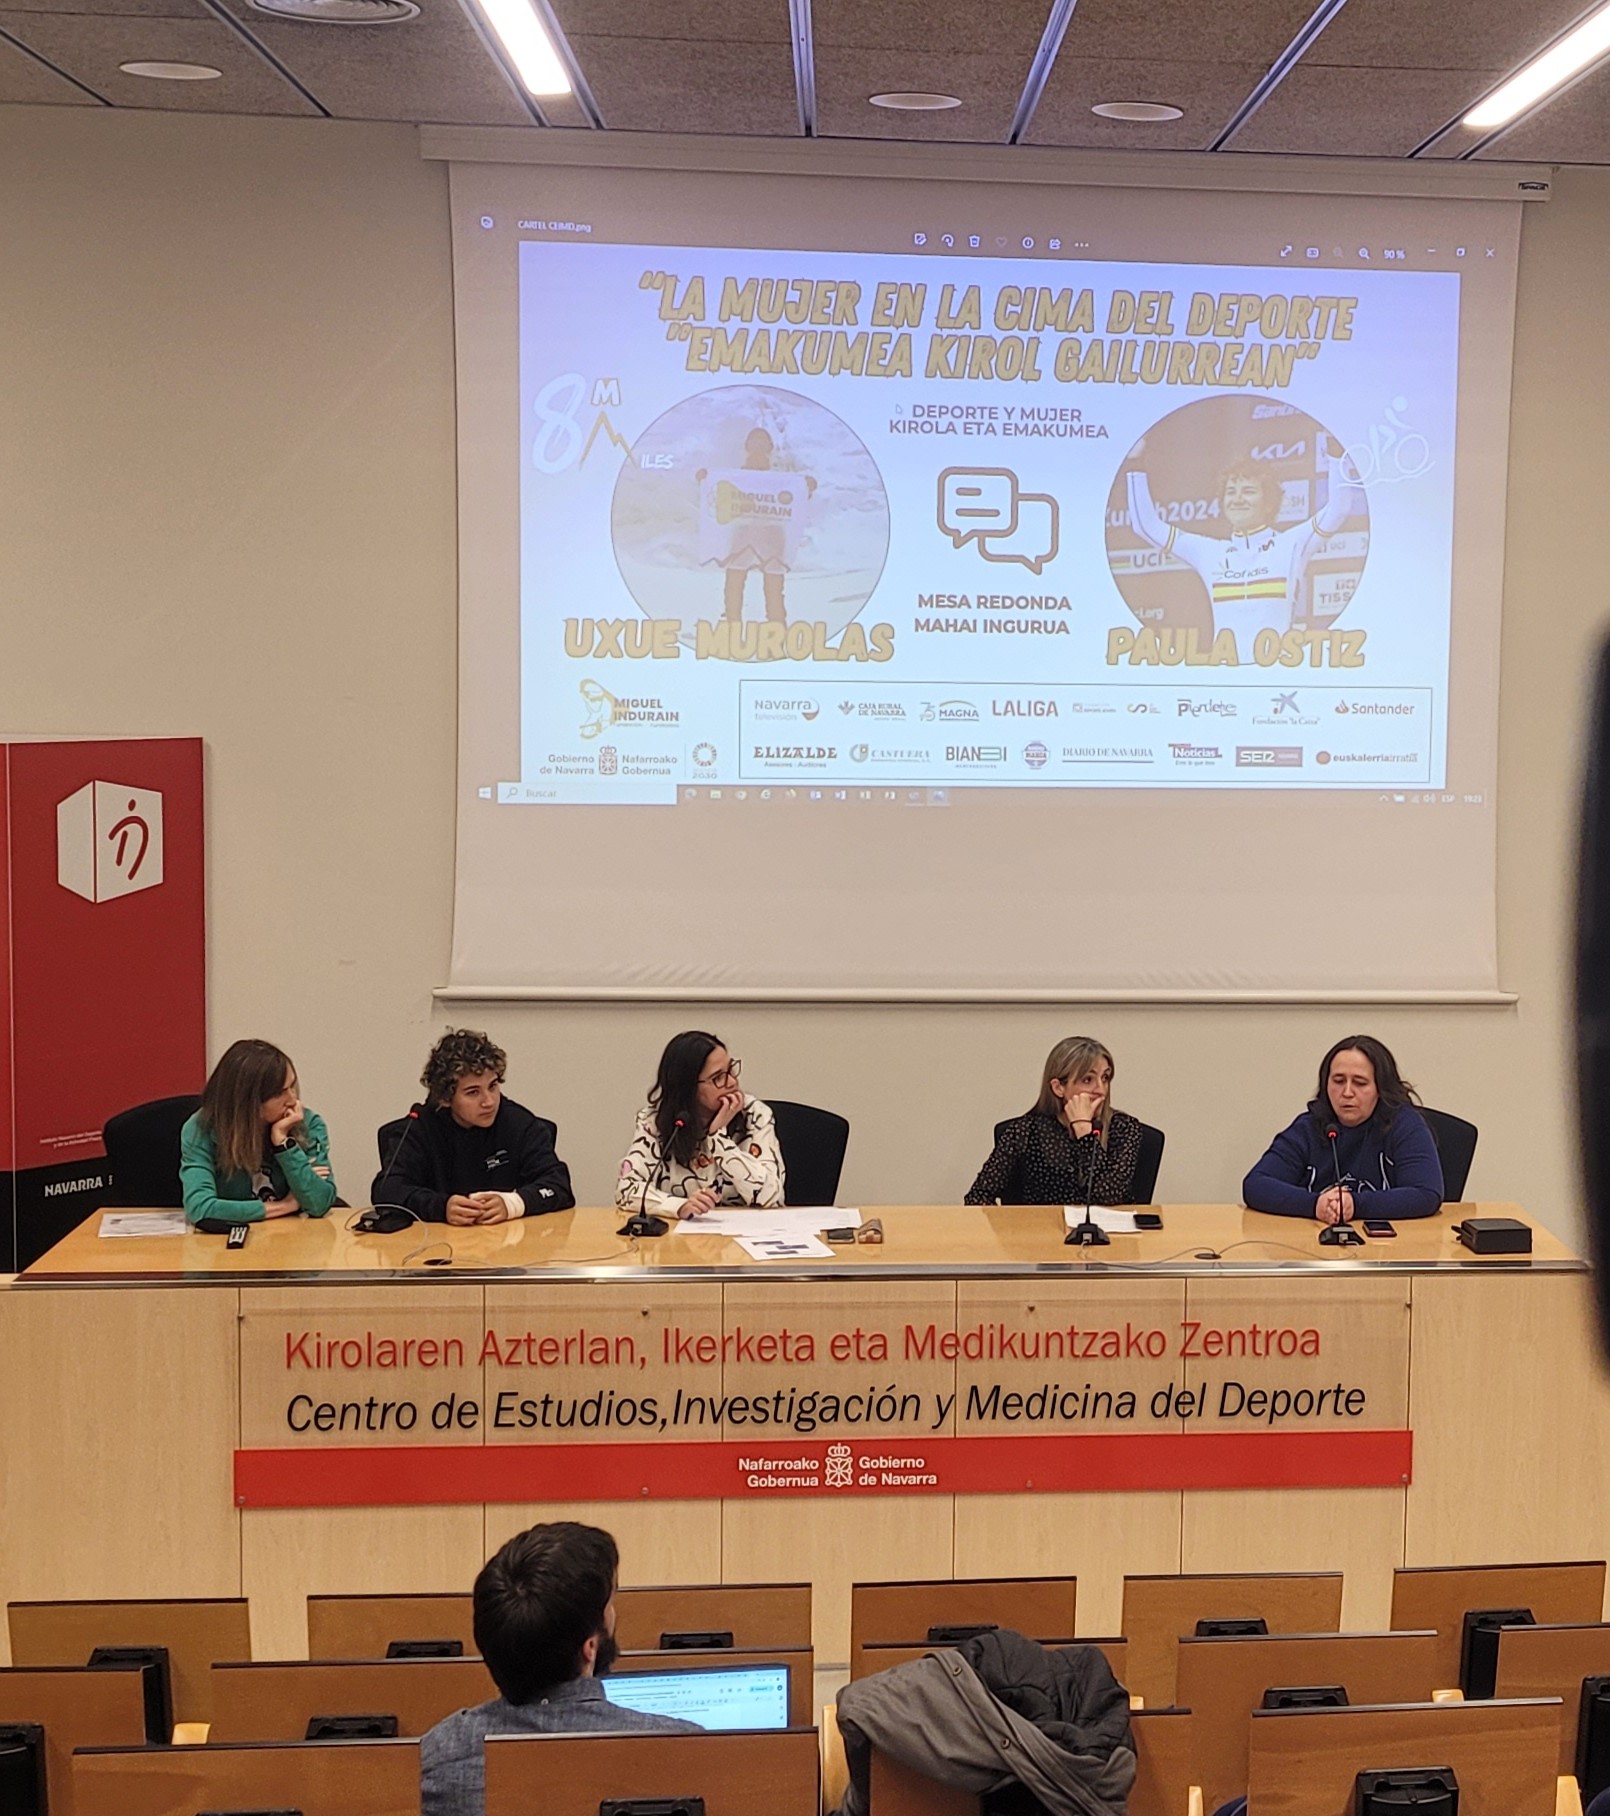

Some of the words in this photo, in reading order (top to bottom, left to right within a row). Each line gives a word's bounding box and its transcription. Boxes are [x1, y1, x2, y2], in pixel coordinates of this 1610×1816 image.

[719, 276, 861, 326] MUJER
[871, 281, 927, 328] EN
[935, 284, 981, 330] LA
[994, 286, 1094, 333] CIMA
[1106, 290, 1176, 336] DEL
[1186, 292, 1358, 341] DEPORTE
[924, 333, 1043, 383] KIROL
[912, 404, 999, 420] DEPORTE
[1003, 406, 1016, 420] Y
[1020, 407, 1082, 423] MUJER
[889, 420, 958, 436] KIROLA
[963, 422, 998, 437] ETA
[1002, 423, 1109, 439] EMAKUMEA
[917, 593, 972, 610] MESA
[976, 595, 1073, 611] REDONDA
[914, 618, 977, 634] MAHAI
[983, 619, 1070, 635] INGURUA
[563, 617, 682, 660] UXUE
[695, 618, 896, 663] MUROLAS
[1106, 627, 1240, 667] PAULA
[1253, 628, 1367, 668] OSTIZ
[614, 698, 663, 709] MIGUEL
[754, 699, 812, 711] Navarra
[992, 699, 1059, 717] LALIGA
[1351, 703, 1415, 716] Santander
[613, 711, 680, 722] INDURAIN
[939, 708, 980, 719] MAGNA
[548, 753, 595, 764] Gobierno
[622, 754, 678, 765] Nafarroako
[753, 746, 838, 759] ELIZALDE
[1174, 747, 1216, 758] Noticias
[539, 765, 553, 775] de
[555, 766, 595, 776] Navarra
[622, 765, 672, 776] Gobernua
[526, 788, 558, 798] Buscar
[44, 1175, 103, 1198] NAVARRA
[285, 1331, 465, 1369] Kirolaren
[478, 1328, 647, 1370] Azterlan,
[662, 1326, 816, 1364] Ikerketa
[829, 1327, 889, 1361] eta
[904, 1322, 1168, 1362] Medikuntzako
[1180, 1321, 1322, 1358] Zentroa
[286, 1394, 418, 1432] Centro
[431, 1393, 480, 1430] de
[931, 1393, 956, 1430] y
[965, 1383, 1137, 1422] Medicina
[1149, 1382, 1206, 1418] del
[1218, 1381, 1367, 1425] Deporte
[738, 1456, 819, 1472] Nafarroako
[858, 1455, 925, 1470] Gobierno
[747, 1474, 819, 1489] Gobernua
[858, 1473, 877, 1487] de
[881, 1472, 938, 1487] Navarra
